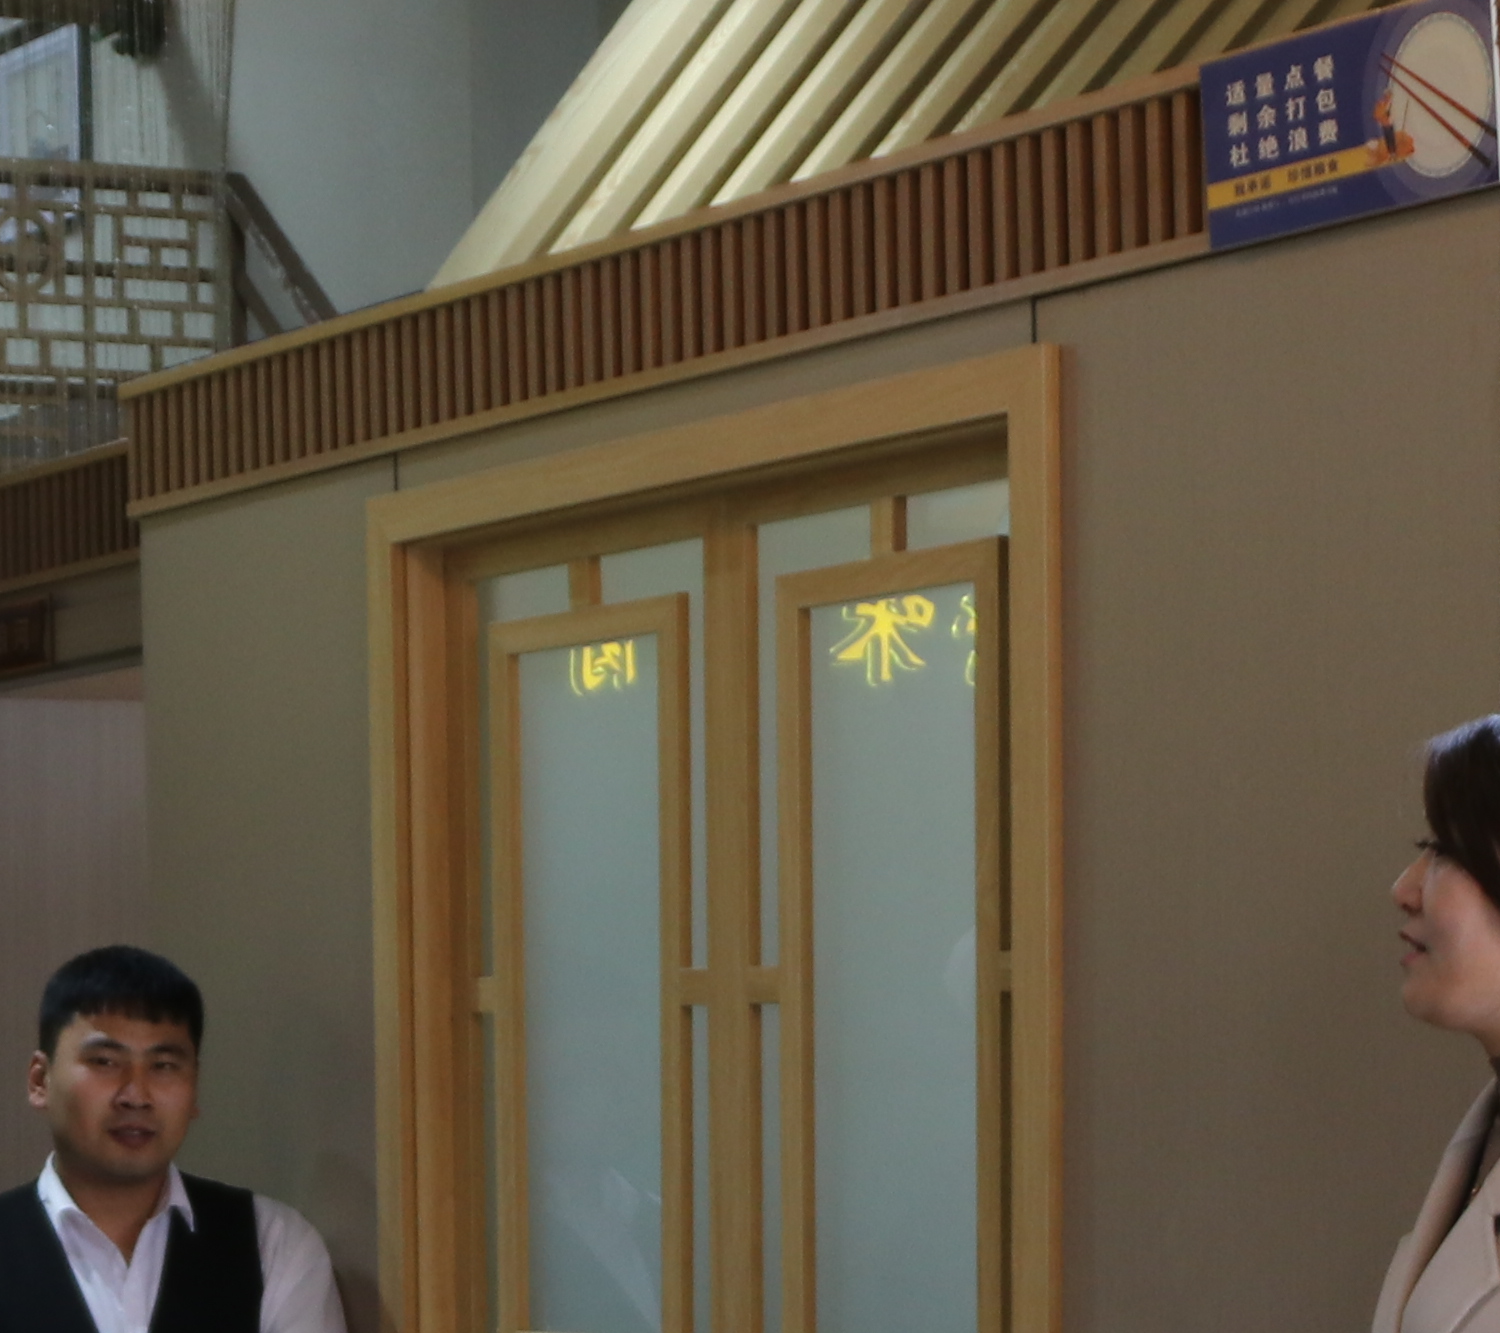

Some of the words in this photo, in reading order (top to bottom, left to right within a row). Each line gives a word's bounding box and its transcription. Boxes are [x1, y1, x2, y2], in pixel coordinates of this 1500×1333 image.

[1225, 53, 1336, 107] 适量点餐
[1227, 87, 1338, 137] 剩余打包
[1229, 119, 1340, 168] 杜绝浪费
